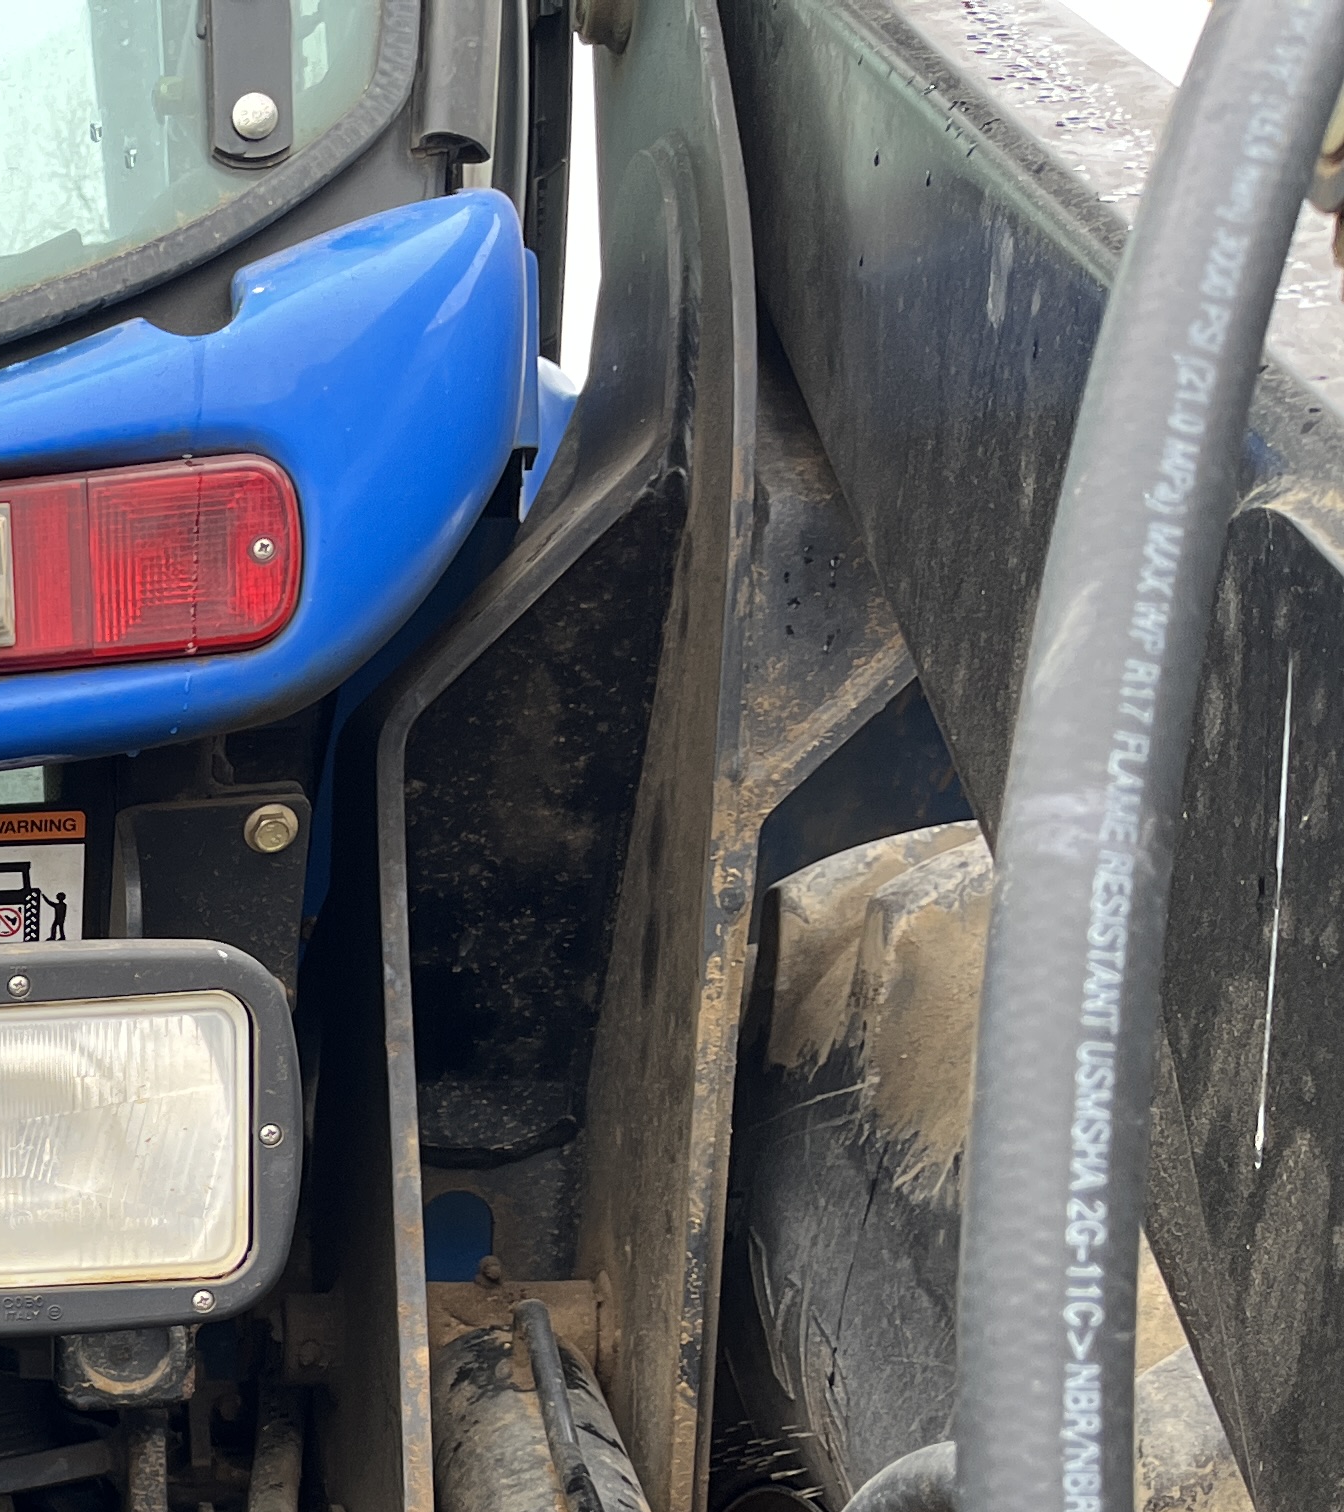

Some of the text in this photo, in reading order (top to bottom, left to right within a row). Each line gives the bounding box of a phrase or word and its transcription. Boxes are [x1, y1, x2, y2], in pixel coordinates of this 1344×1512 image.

[1187, 300, 1233, 352] PSI
[1136, 523, 1185, 599] MAX
[1118, 656, 1160, 728] R17
[1098, 733, 1153, 845] FLAME
[1080, 847, 1134, 1034] RESISTANT
